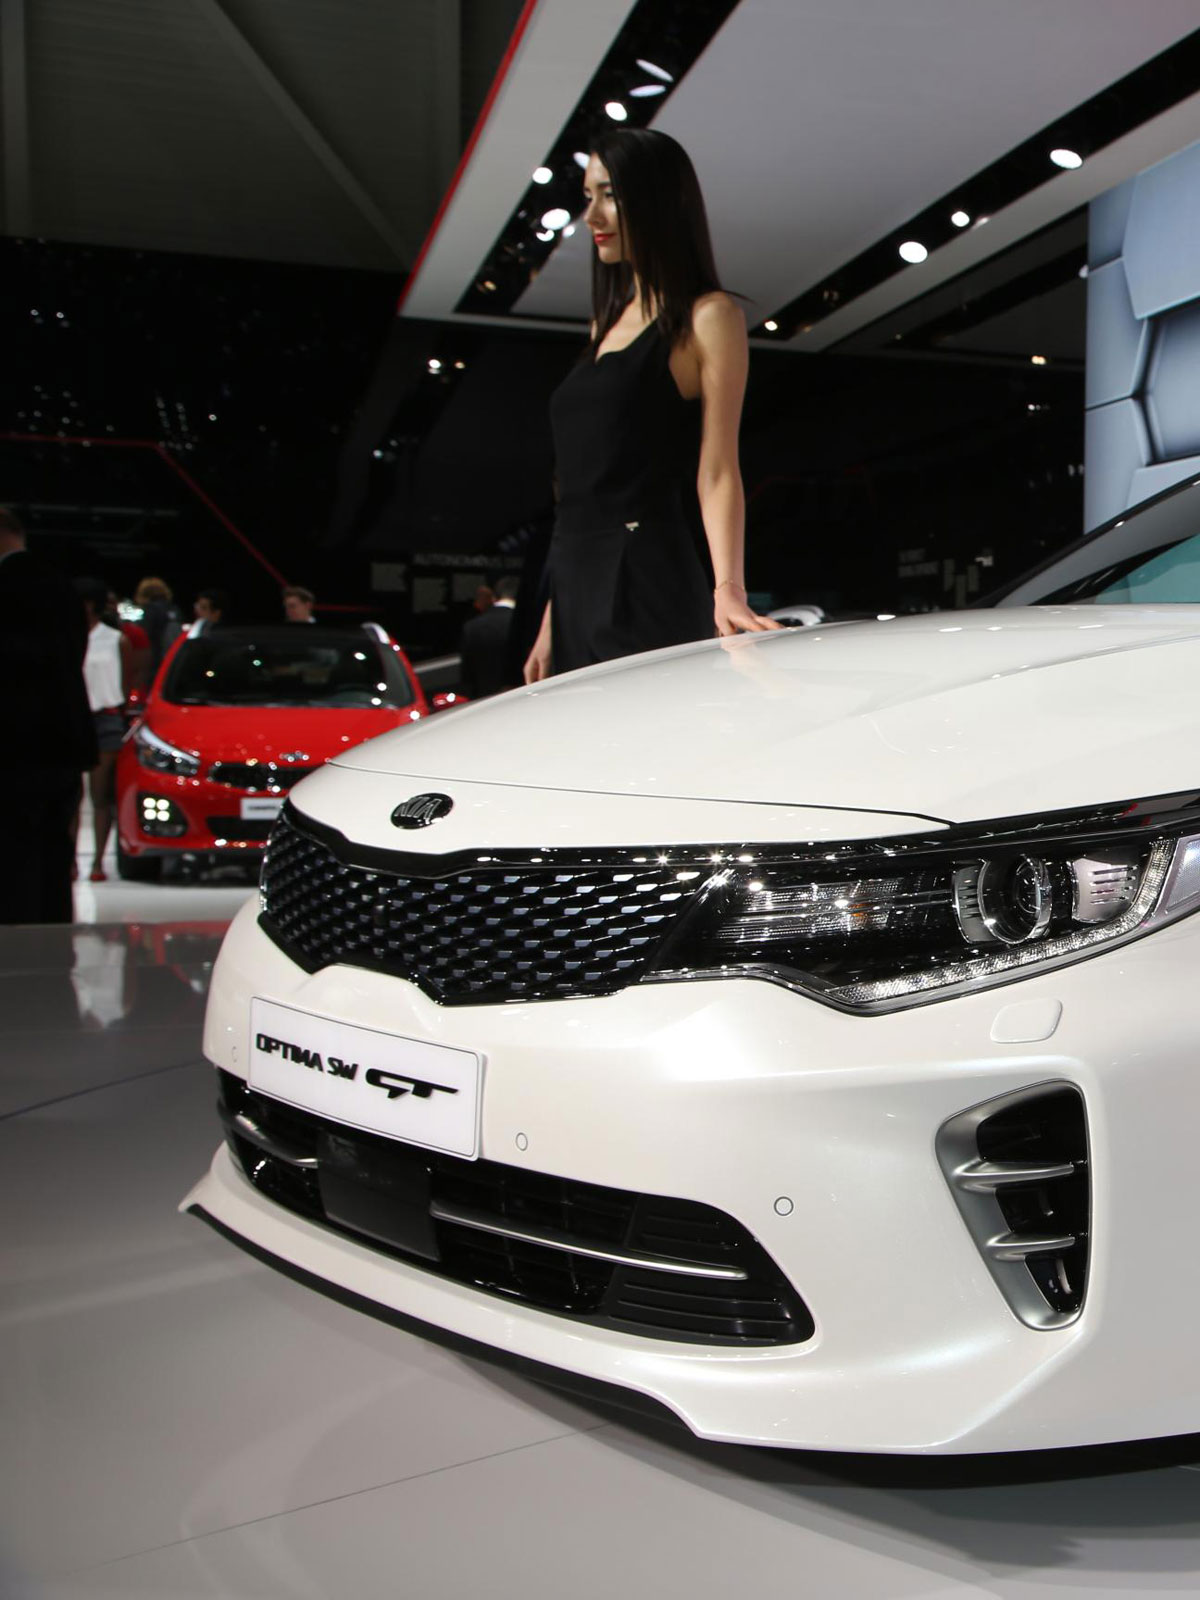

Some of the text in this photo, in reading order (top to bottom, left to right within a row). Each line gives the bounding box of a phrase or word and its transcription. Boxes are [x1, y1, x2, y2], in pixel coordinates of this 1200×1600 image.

[392, 796, 443, 825] KIA
[256, 1032, 460, 1099] OPTIMA SW GT
